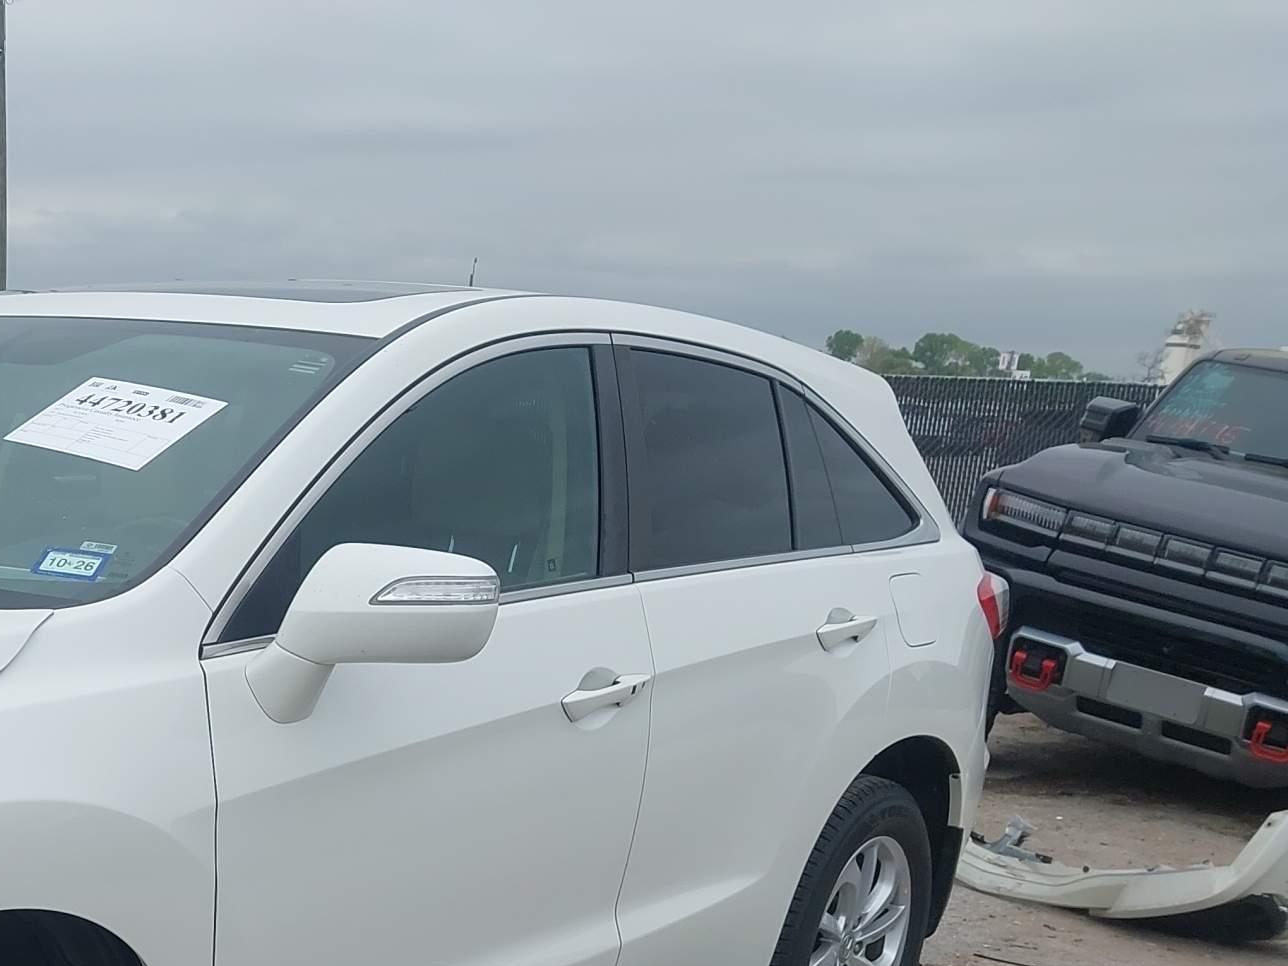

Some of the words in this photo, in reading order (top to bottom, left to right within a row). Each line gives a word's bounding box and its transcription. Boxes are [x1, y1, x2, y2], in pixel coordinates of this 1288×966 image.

[75, 393, 188, 424] 44720381
[48, 557, 67, 568] 10
[73, 560, 96, 571] 26
